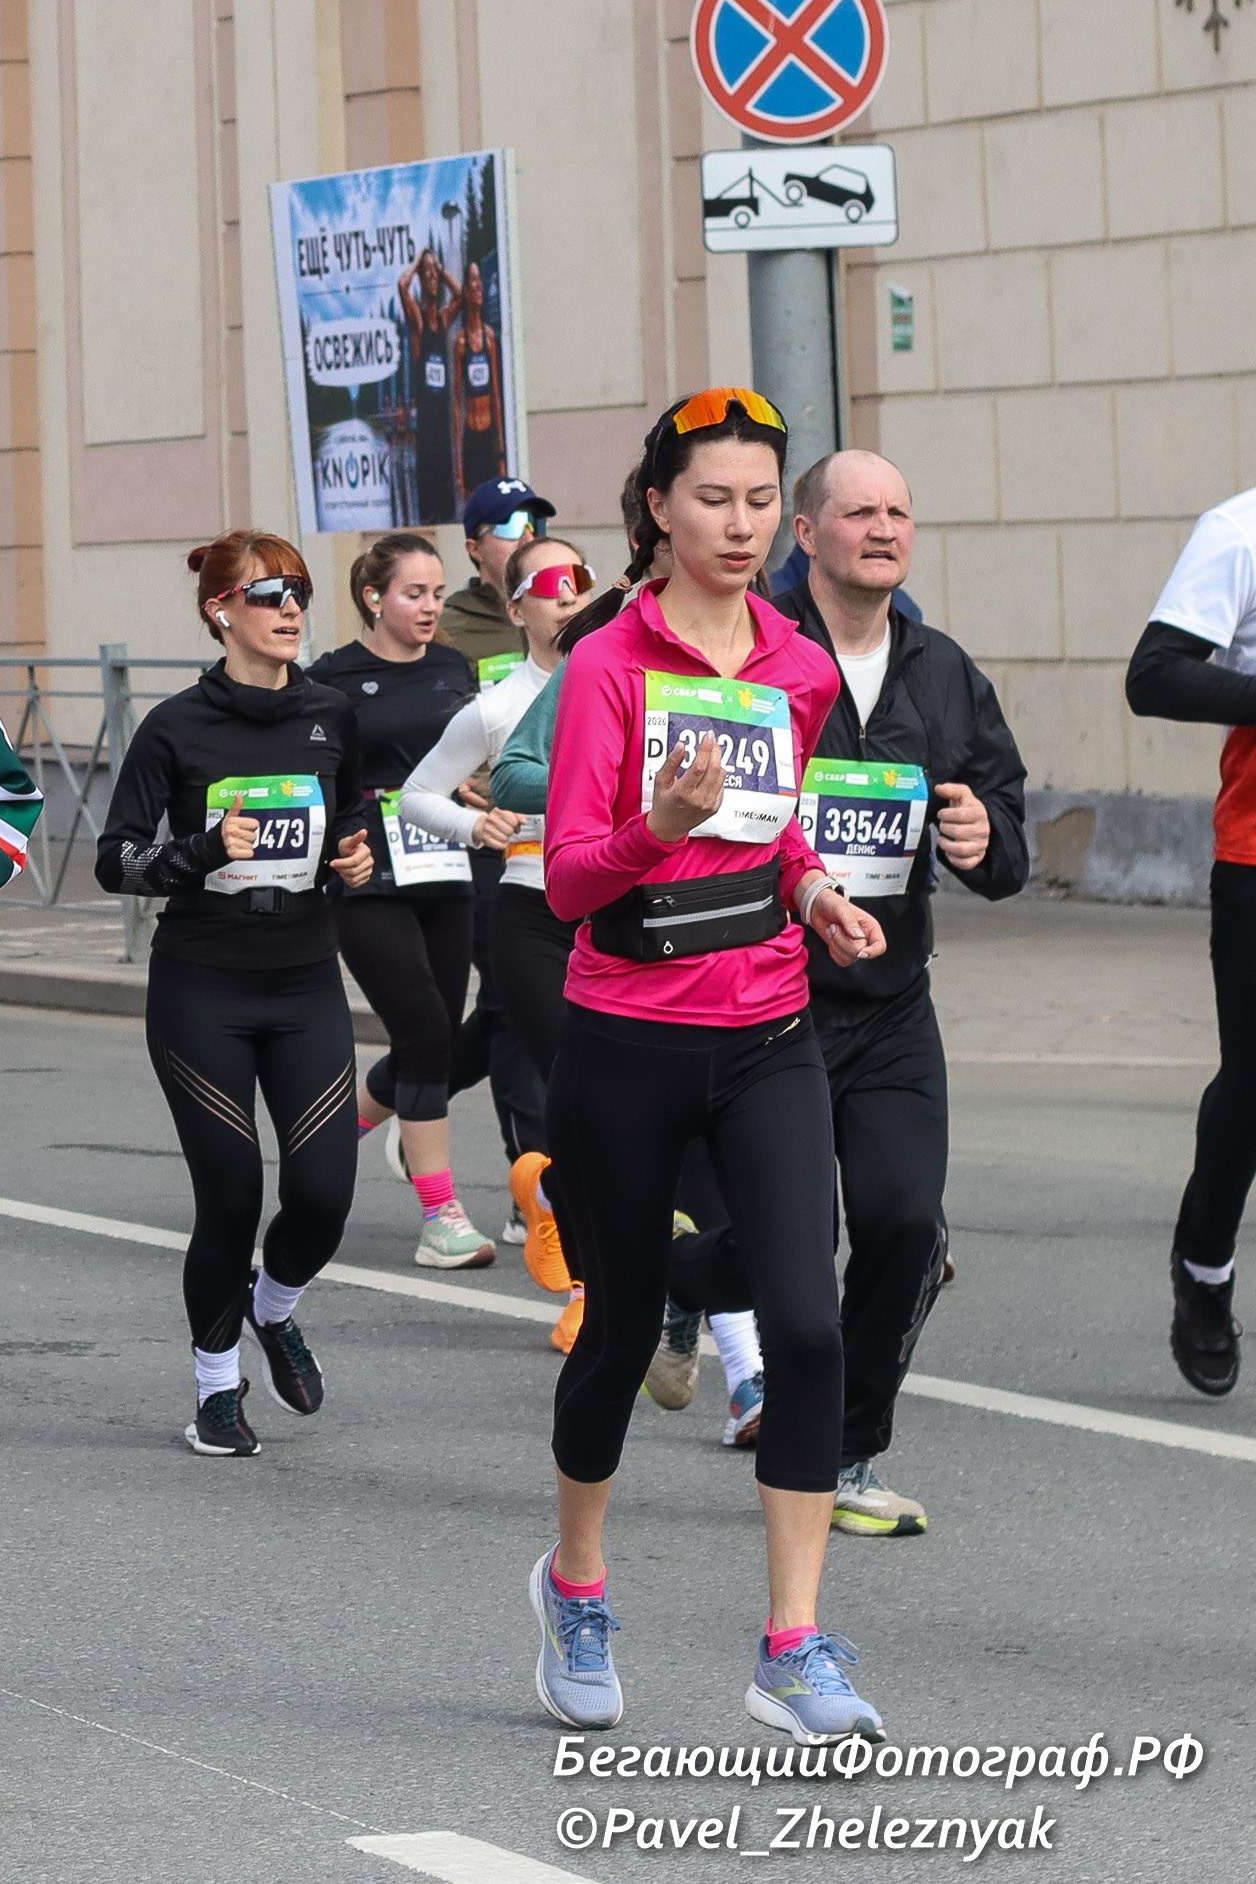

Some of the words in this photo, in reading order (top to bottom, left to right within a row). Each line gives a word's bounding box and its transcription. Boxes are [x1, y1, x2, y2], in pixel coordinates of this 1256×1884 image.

[298, 226, 330, 280] ЕЩЁ
[333, 224, 416, 272] ЧУТЬ-ЧУТЬ
[313, 329, 394, 371] ОСВЕЖИСЬ
[320, 449, 390, 490] KNOPIK
[647, 716, 667, 726] 2026
[647, 738, 664, 758] D
[723, 775, 742, 788] ЕСЯ
[253, 818, 305, 849] 473
[824, 807, 902, 845] 33544
[845, 843, 876, 856] ДЕНИС
